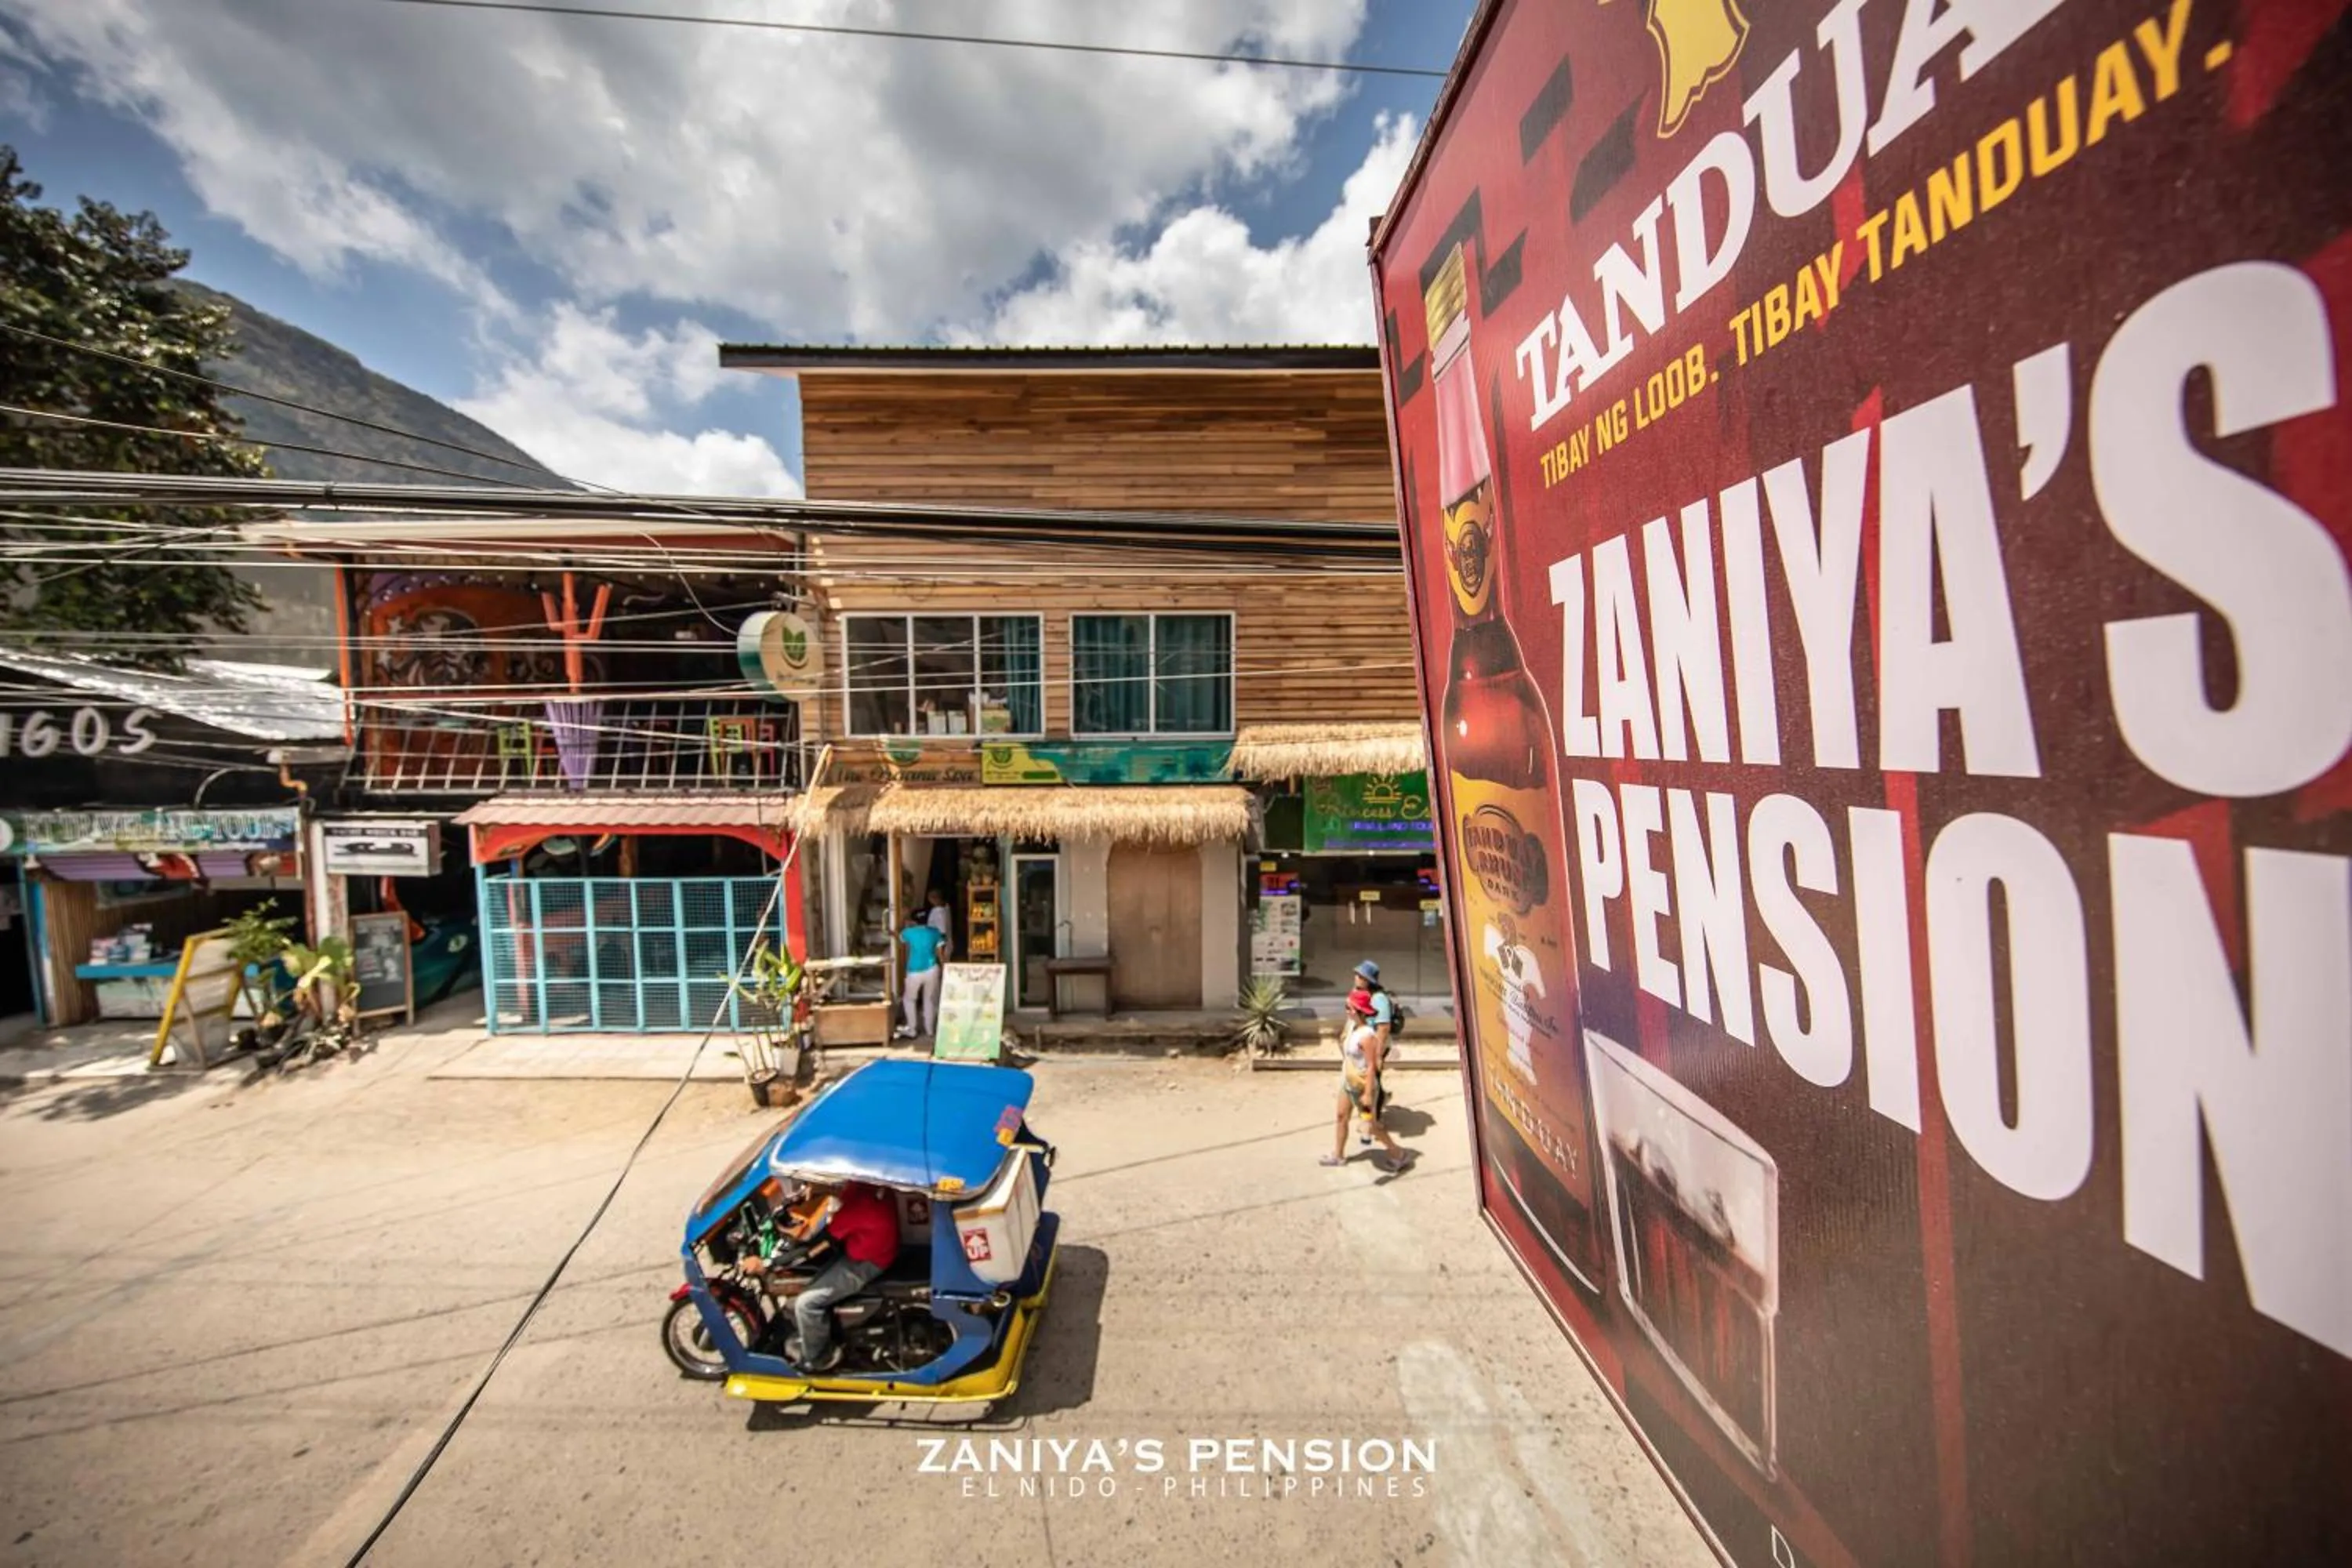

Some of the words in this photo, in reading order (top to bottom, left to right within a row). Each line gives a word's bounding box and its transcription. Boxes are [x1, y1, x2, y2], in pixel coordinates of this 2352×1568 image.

[1540, 424, 1590, 489] TIBAY
[1595, 400, 1628, 455] NG
[1634, 343, 1719, 431] LOOB.
[1729, 239, 1843, 367] TIBAY
[1856, 0, 2233, 284] TANDUAY.
[1548, 260, 2352, 797] ZANIYA'S
[1572, 779, 2352, 1360] PENSION
